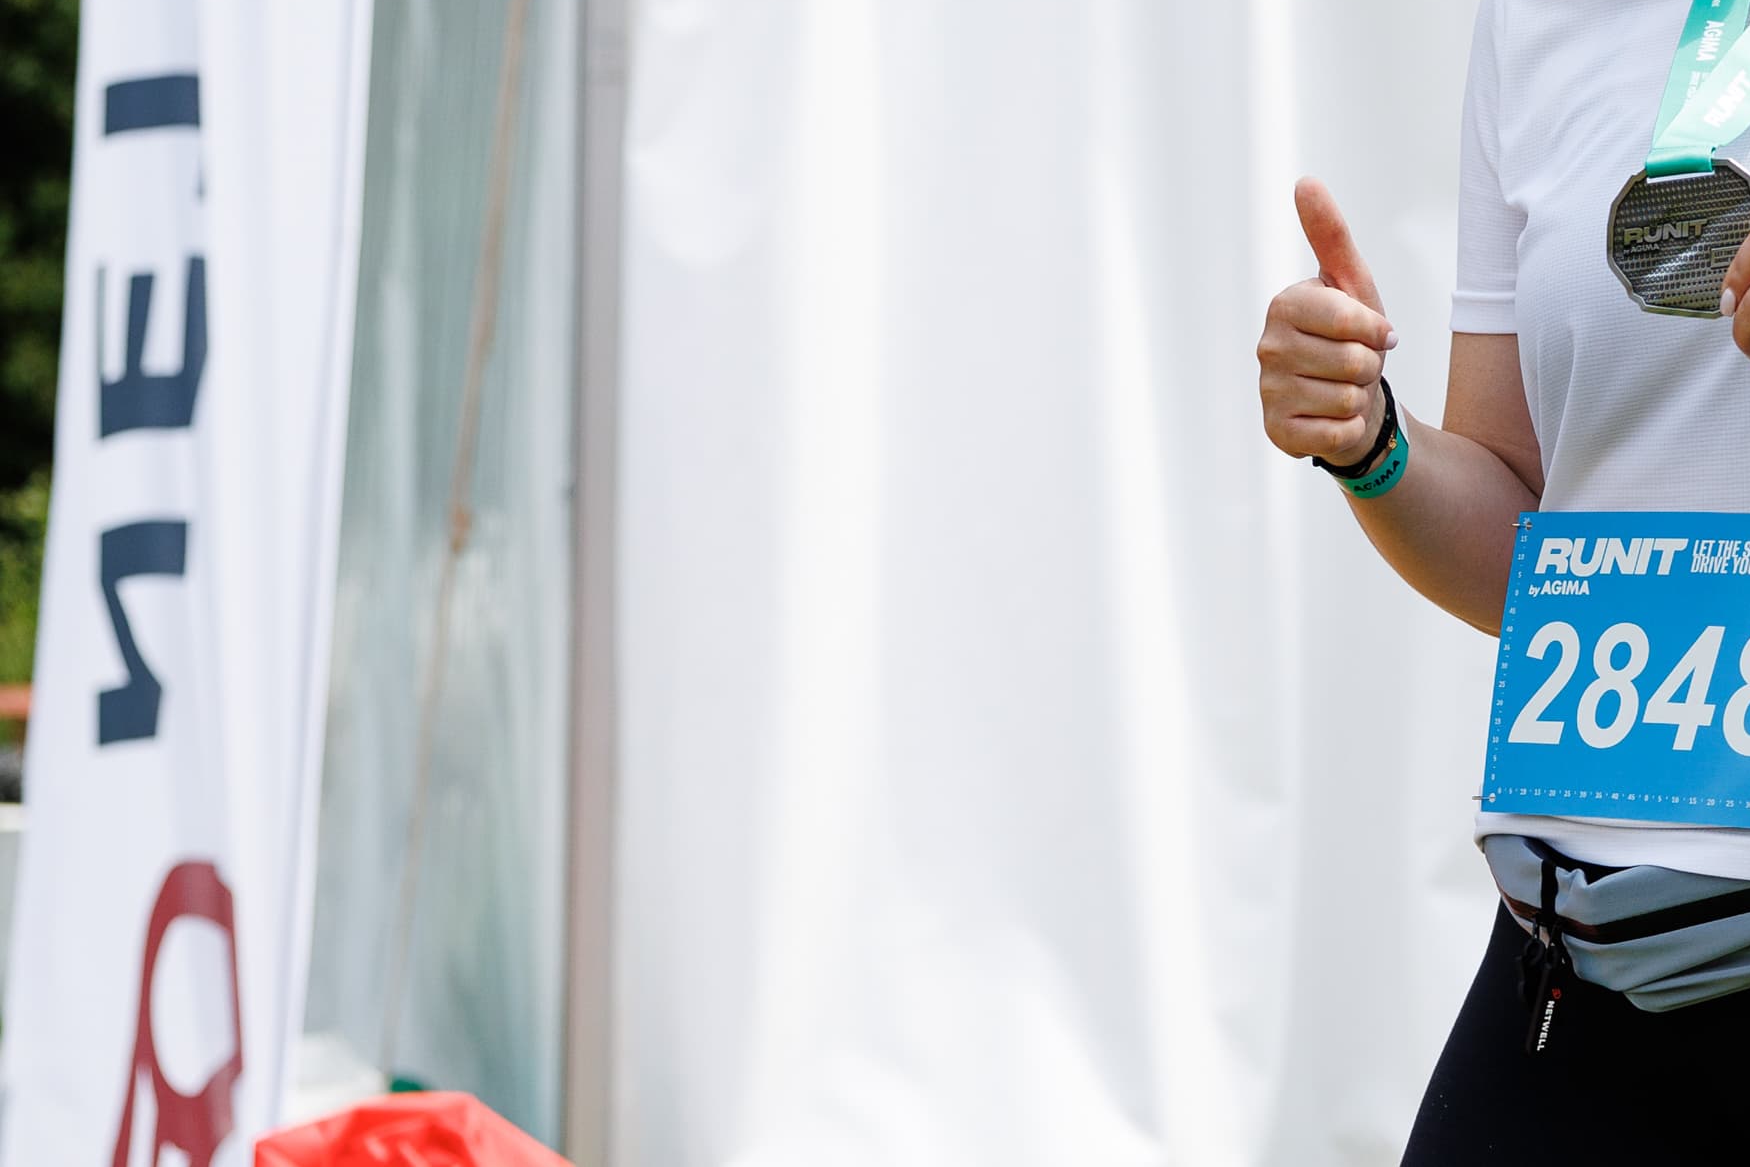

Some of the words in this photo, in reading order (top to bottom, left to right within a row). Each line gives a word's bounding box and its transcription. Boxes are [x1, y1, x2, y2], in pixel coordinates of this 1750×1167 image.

[1695, 20, 1724, 60] AGIMA
[1624, 218, 1708, 246] RUNIT
[1630, 243, 1660, 253] AGIMA
[1353, 459, 1400, 492] AGIMA
[1534, 538, 1688, 578] RUNIT
[1692, 539, 1716, 556] LET
[1716, 540, 1742, 558] THE
[1690, 554, 1729, 574] DRIVE
[1528, 584, 1540, 598] by
[1540, 580, 1590, 595] AGIMA
[1536, 1000, 1555, 1051] NETWELL
